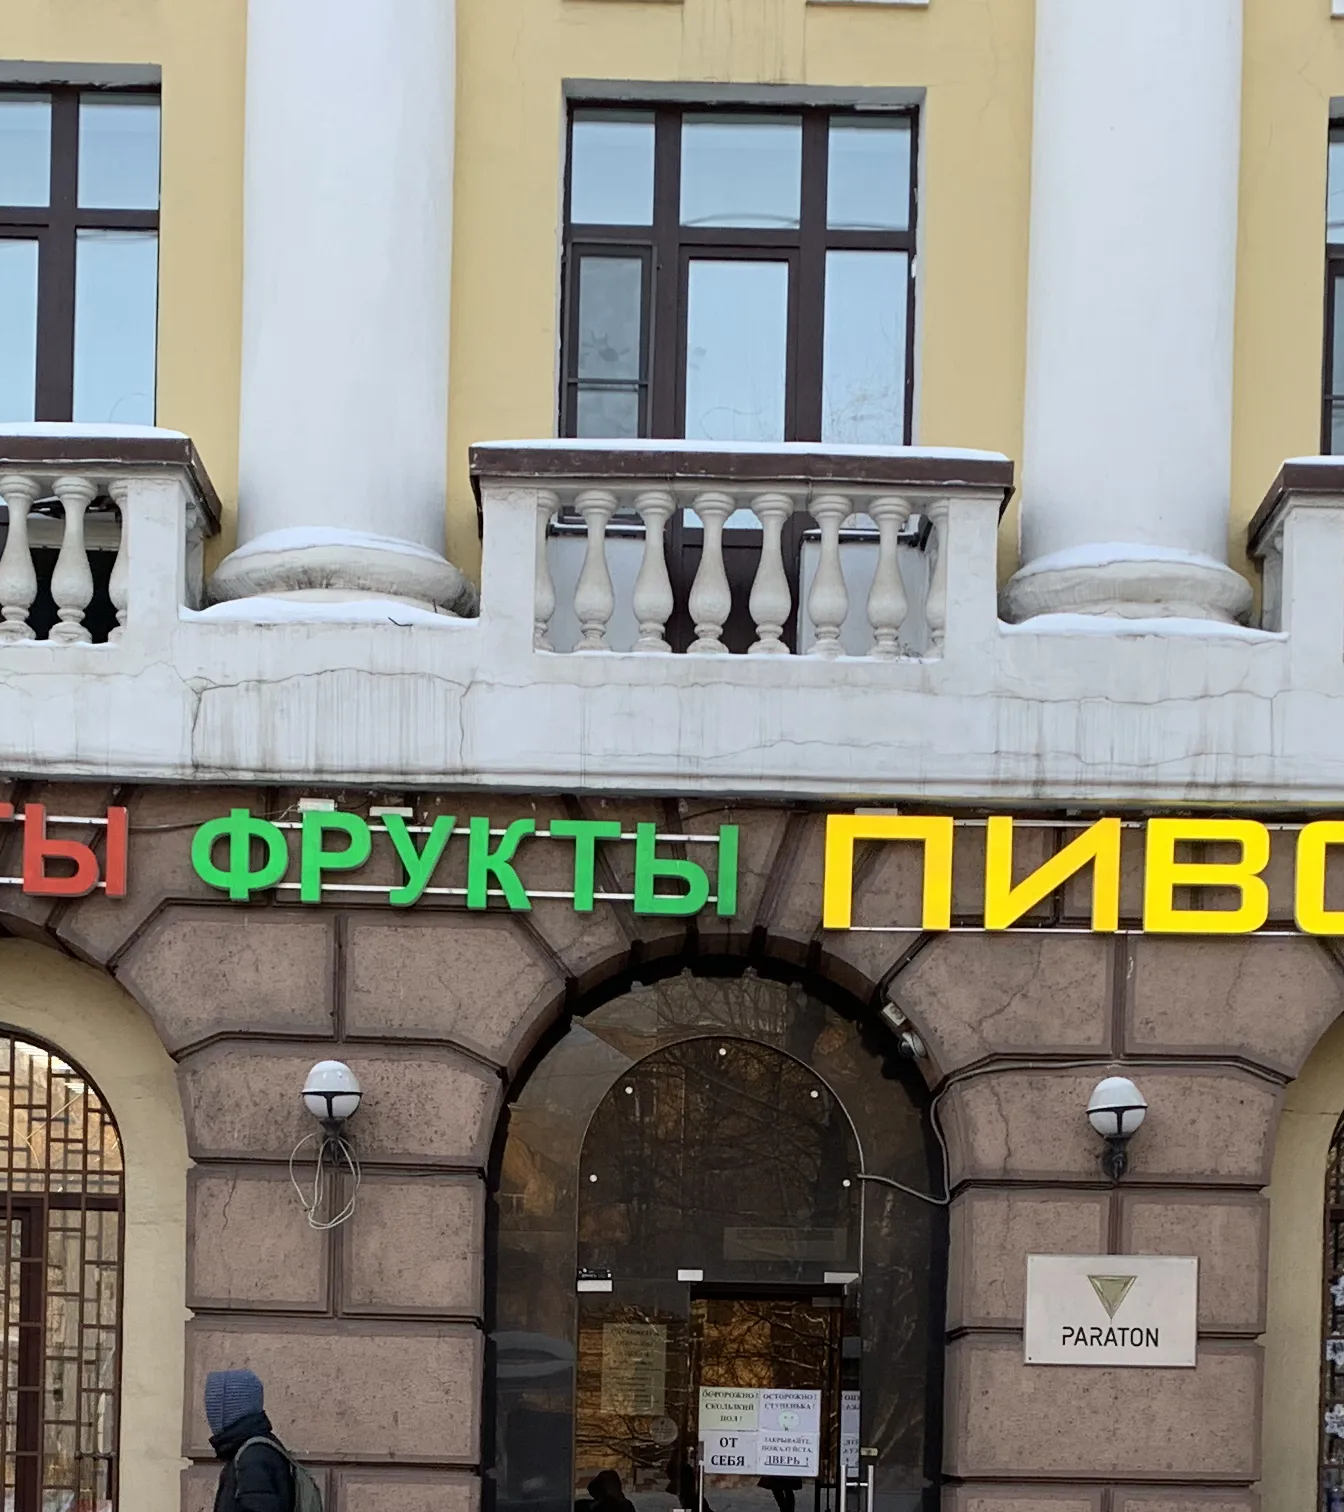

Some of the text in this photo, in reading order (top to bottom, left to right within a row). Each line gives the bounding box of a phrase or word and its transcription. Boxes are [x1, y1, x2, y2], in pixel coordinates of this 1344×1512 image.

[191, 808, 740, 917] ФРУКТЫ
[1062, 1326, 1159, 1348] PARATON
[719, 1437, 739, 1448] ОТ
[710, 1454, 745, 1466] СЕБЯ
